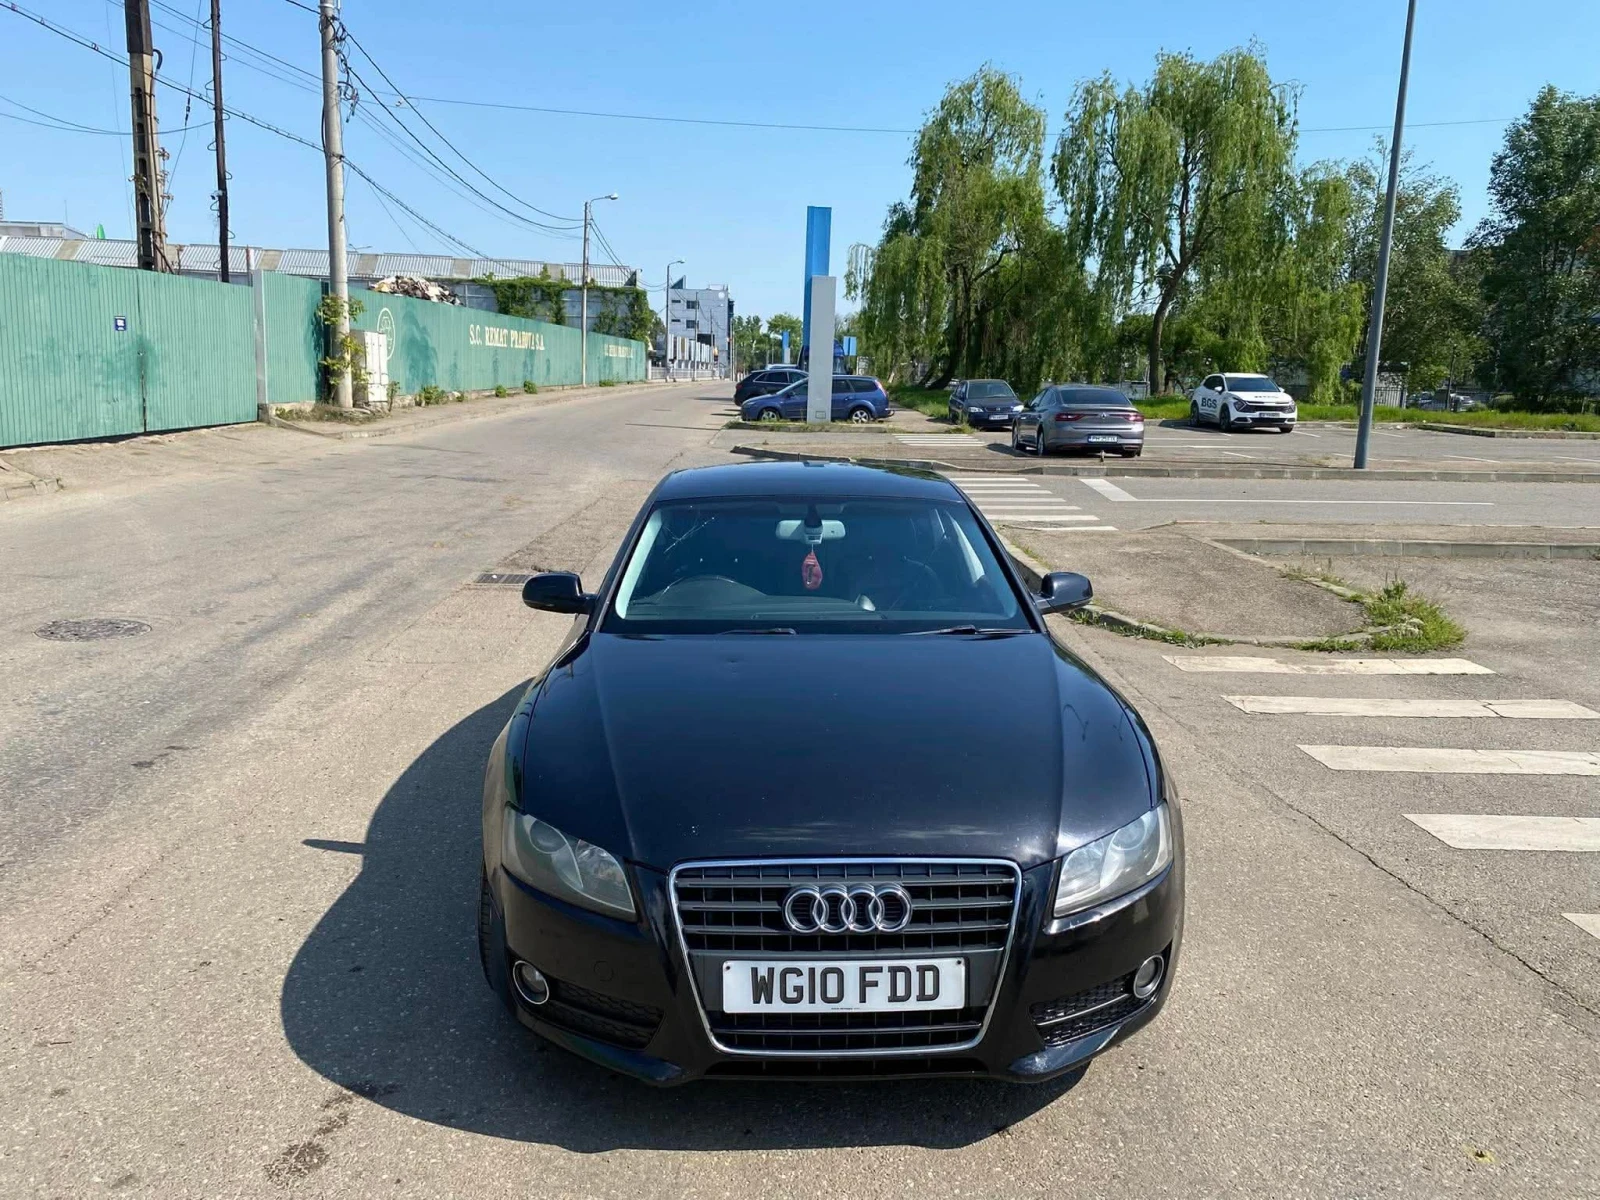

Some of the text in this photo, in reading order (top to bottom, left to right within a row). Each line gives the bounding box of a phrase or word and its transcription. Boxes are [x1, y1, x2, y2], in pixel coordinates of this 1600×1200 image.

[469, 323, 482, 345] S.C.
[1201, 397, 1217, 409] BGS
[859, 964, 940, 1004] FDD
